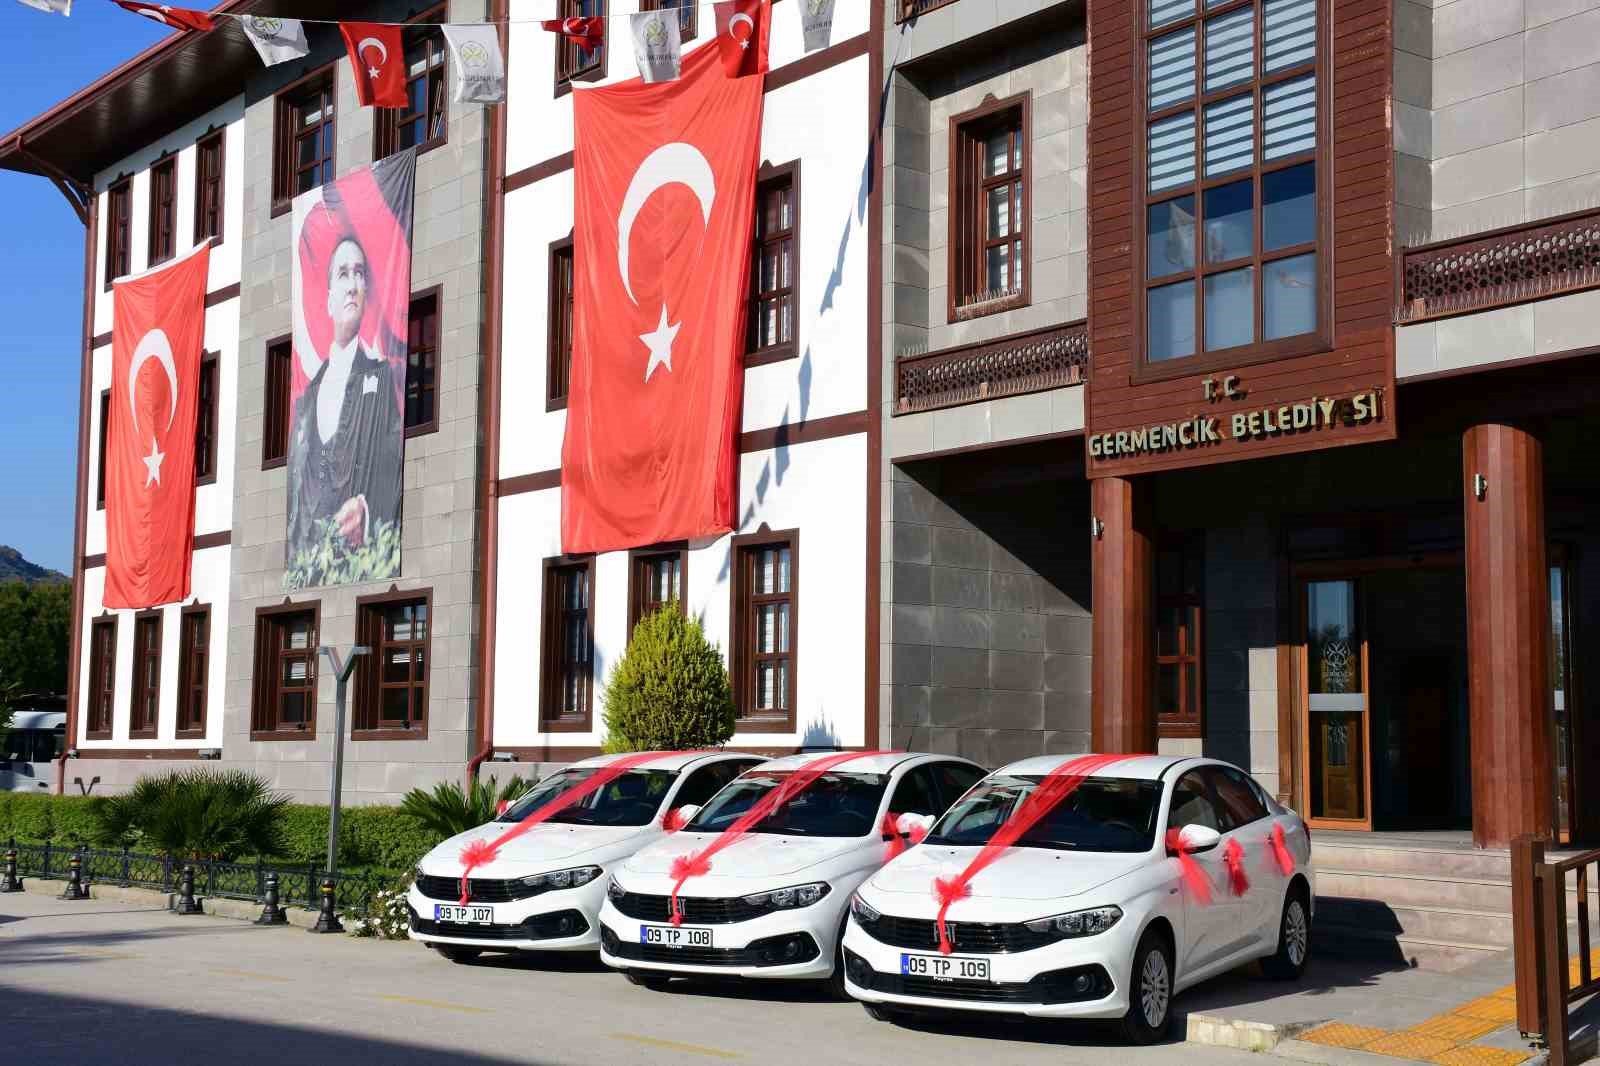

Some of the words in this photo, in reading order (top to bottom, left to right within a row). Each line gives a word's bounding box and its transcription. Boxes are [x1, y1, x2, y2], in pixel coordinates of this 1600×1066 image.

[1088, 414, 1218, 456] GERMENCİK
[440, 907, 452, 919] 09
[455, 908, 467, 920] TP
[473, 908, 490, 921] 107
[647, 928, 662, 942] 09
[666, 929, 680, 943] TP
[688, 931, 709, 945] 108
[909, 957, 927, 974] 09
[933, 959, 950, 975] TP
[960, 961, 987, 978] 109
